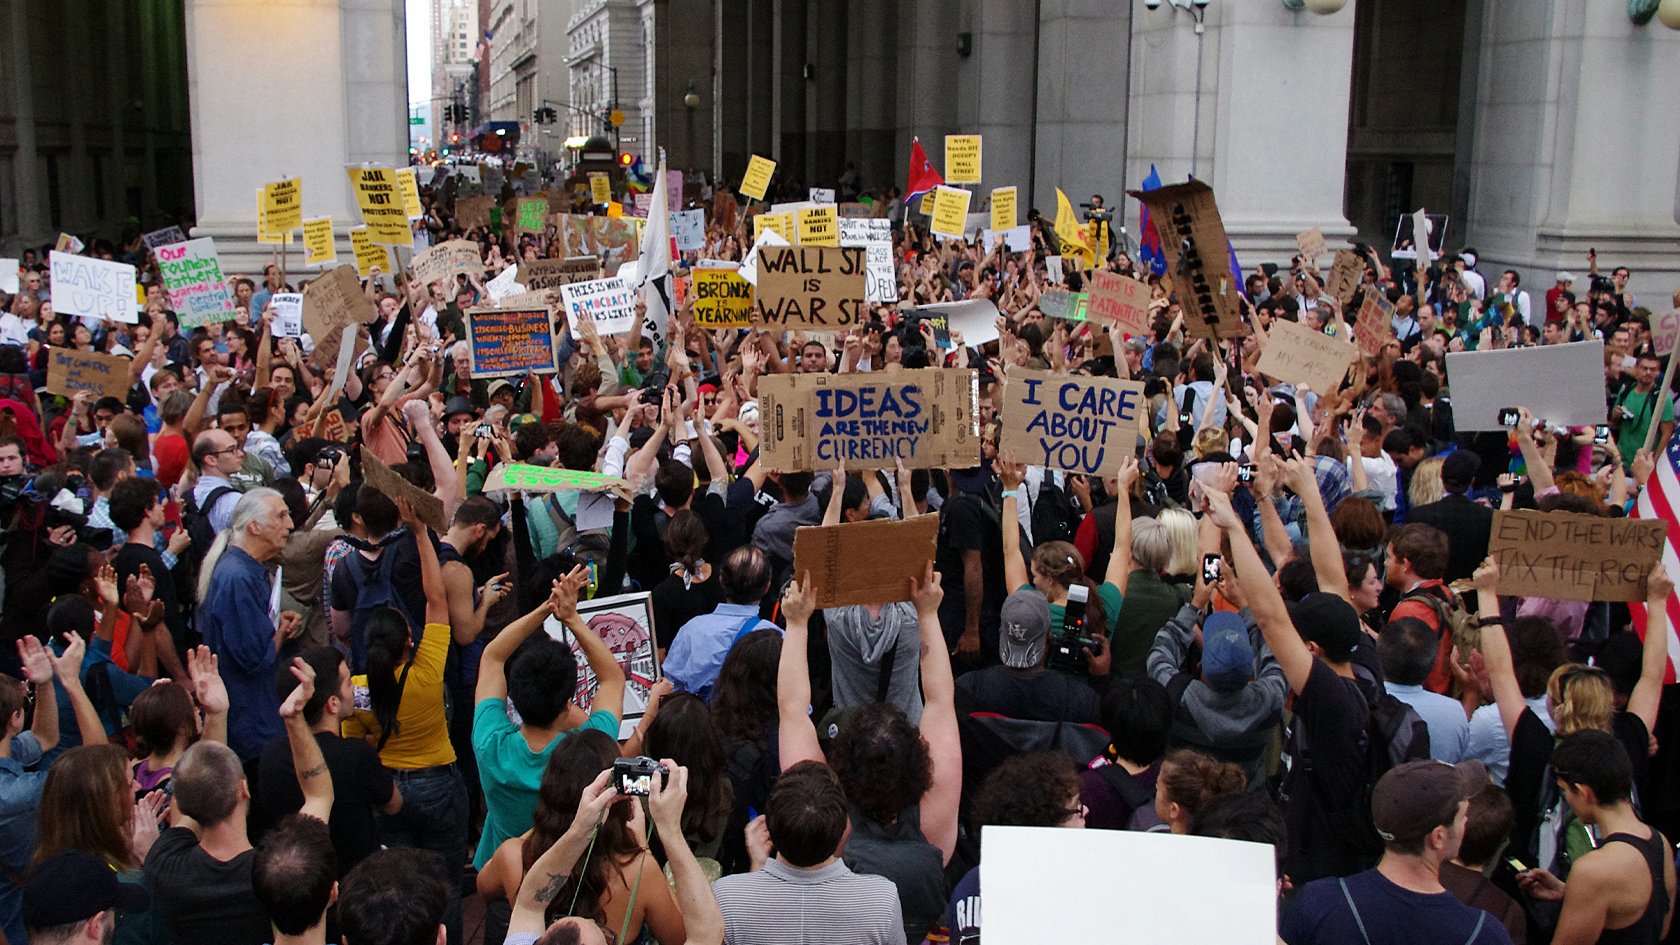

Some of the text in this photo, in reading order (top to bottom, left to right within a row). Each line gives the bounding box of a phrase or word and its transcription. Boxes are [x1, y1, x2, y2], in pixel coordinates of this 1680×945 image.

[361, 170, 386, 182] JAIL
[360, 183, 393, 192] BANKERS
[367, 193, 391, 205] NOT
[521, 211, 541, 220] GET
[803, 217, 832, 225] BANKERS
[807, 208, 827, 218] JAIL
[518, 219, 544, 230] FREE
[809, 225, 827, 233] NOT
[159, 246, 187, 262] Our
[758, 249, 865, 275] WALL ST.
[158, 252, 220, 277] Founding
[528, 265, 556, 277] NYPD
[53, 260, 133, 298] WAKE
[165, 269, 224, 290] Fathers
[540, 274, 562, 291] SAVE
[567, 278, 624, 298] THIS IS WHAT
[803, 278, 820, 292] IS
[878, 278, 897, 299] FED
[1095, 272, 1136, 298] THIS IS
[167, 281, 226, 299] warned us
[314, 284, 342, 316] SPARE
[696, 281, 750, 299] BRONX
[71, 290, 128, 317] UP!
[571, 293, 629, 313] DEMOCRACY
[609, 306, 633, 319] LIKE!
[717, 300, 728, 308] IS
[758, 298, 827, 325] WAR
[1090, 293, 1145, 326] PATRIOTIC
[508, 322, 549, 334] BUSINESS
[1273, 350, 1331, 379] MY ASS
[814, 385, 923, 420] IDEAS
[1021, 378, 1139, 421] I CARE
[819, 417, 930, 438] ARE THE NEW
[1026, 409, 1117, 446] ABOUT
[817, 436, 919, 463] CURRENCY
[1039, 437, 1106, 474] YOU
[1497, 514, 1662, 549] END THE WARS
[1492, 546, 1649, 590] TAX THE RICH
[1007, 621, 1028, 641] NY
